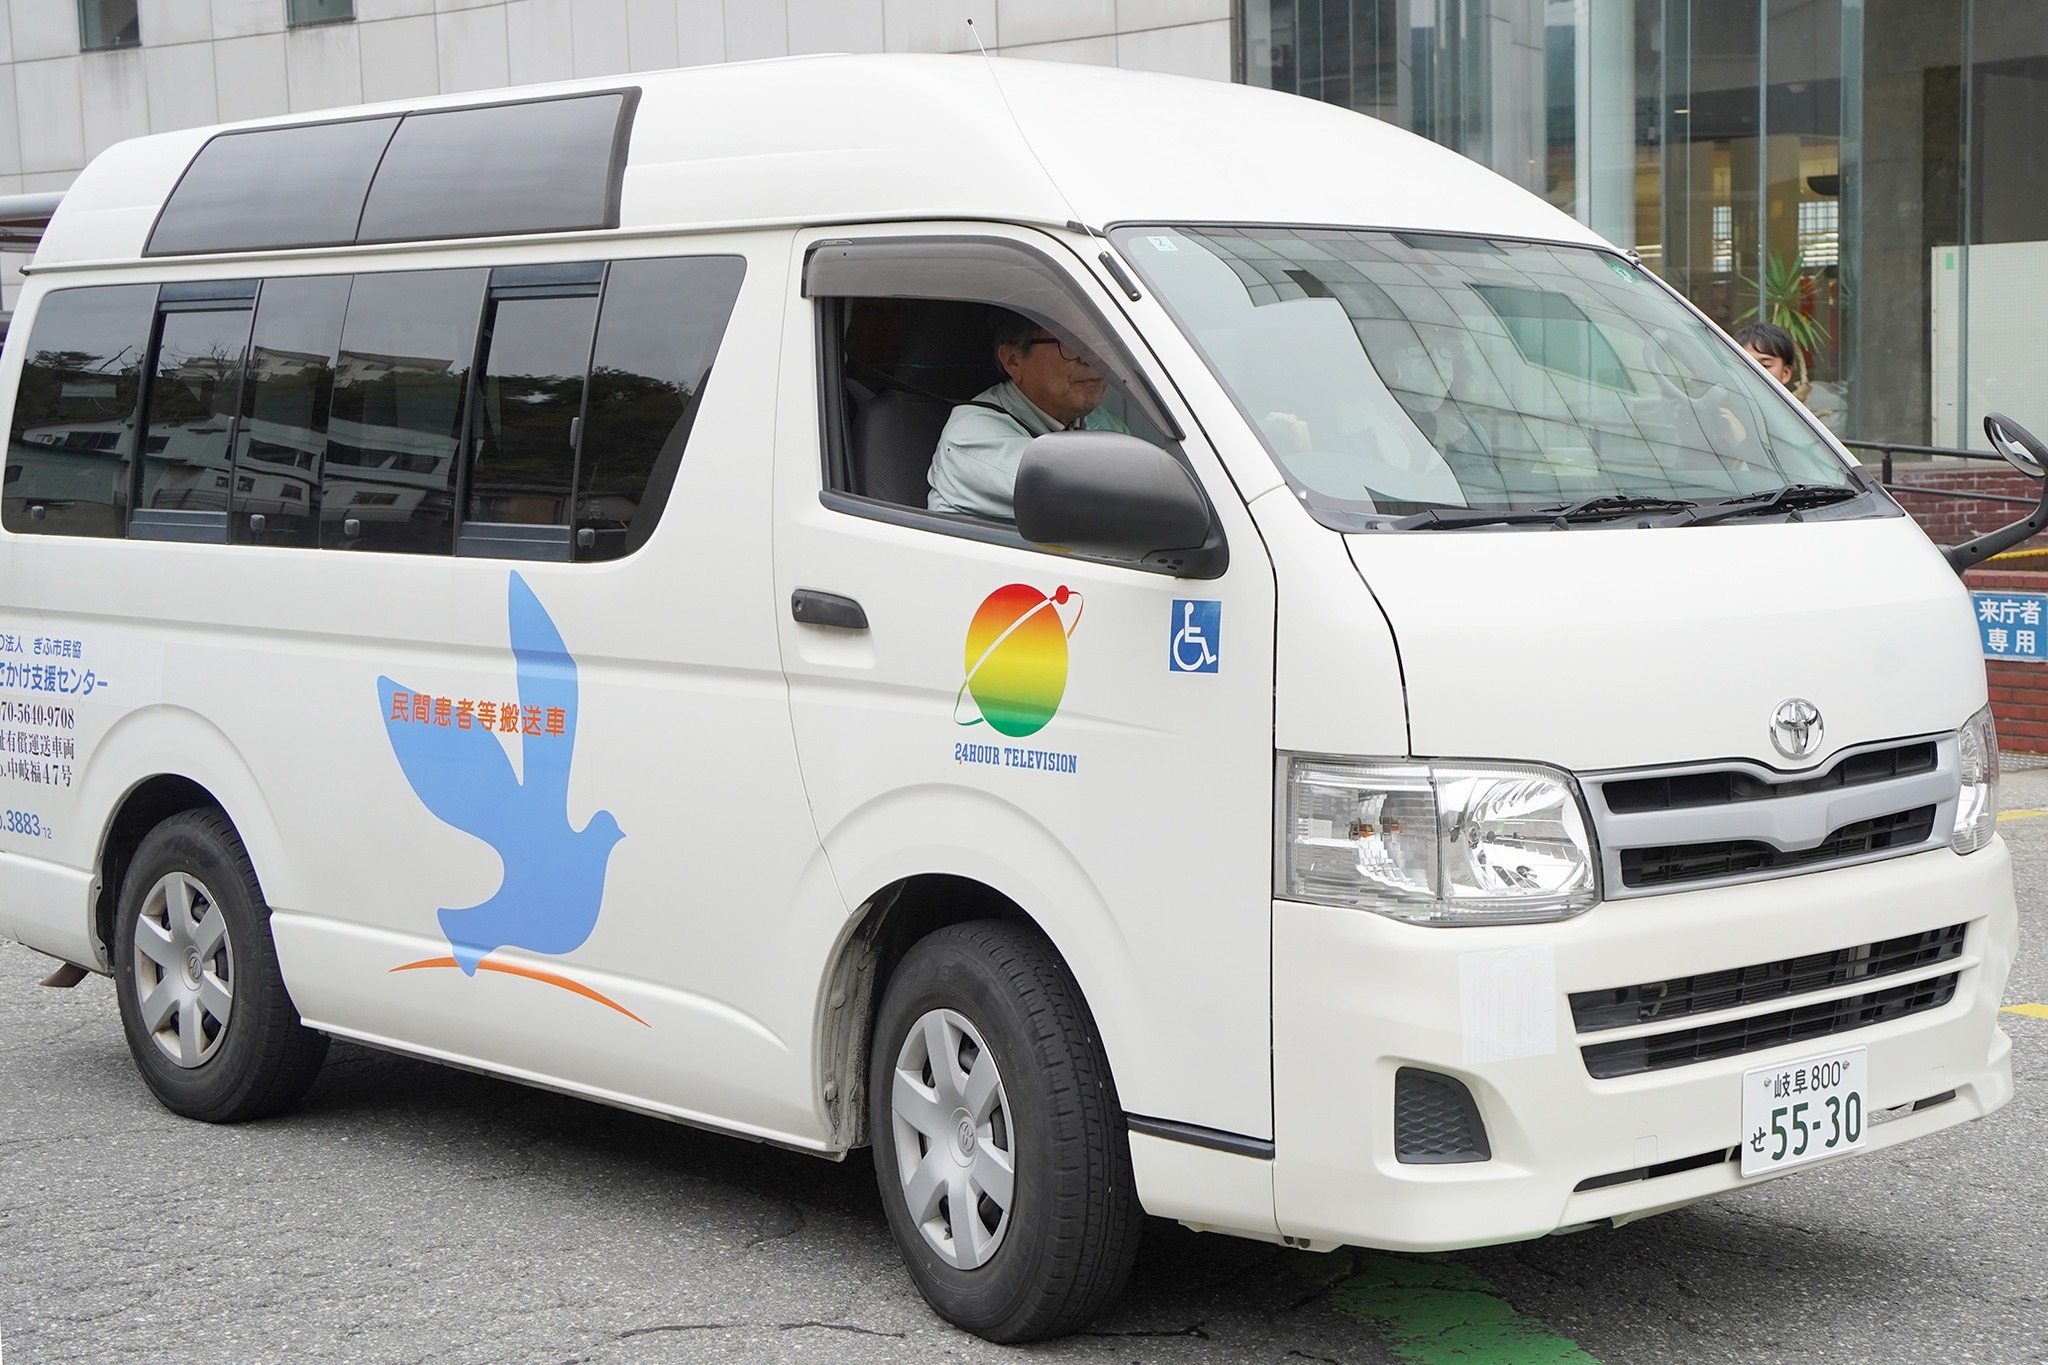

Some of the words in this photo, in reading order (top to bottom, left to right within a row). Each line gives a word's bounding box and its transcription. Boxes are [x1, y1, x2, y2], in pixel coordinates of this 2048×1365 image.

[1978, 598, 2042, 626] 来庁者
[1987, 627, 2036, 654] 専用
[0, 701, 75, 730] 70-5640-9708
[390, 691, 567, 738] 民間患者等搬送車
[954, 742, 1000, 766] 24HOUR
[1004, 747, 1078, 774] TELEVISION
[1750, 1126, 1767, 1153] せ
[1771, 1091, 1861, 1161] 55-30
